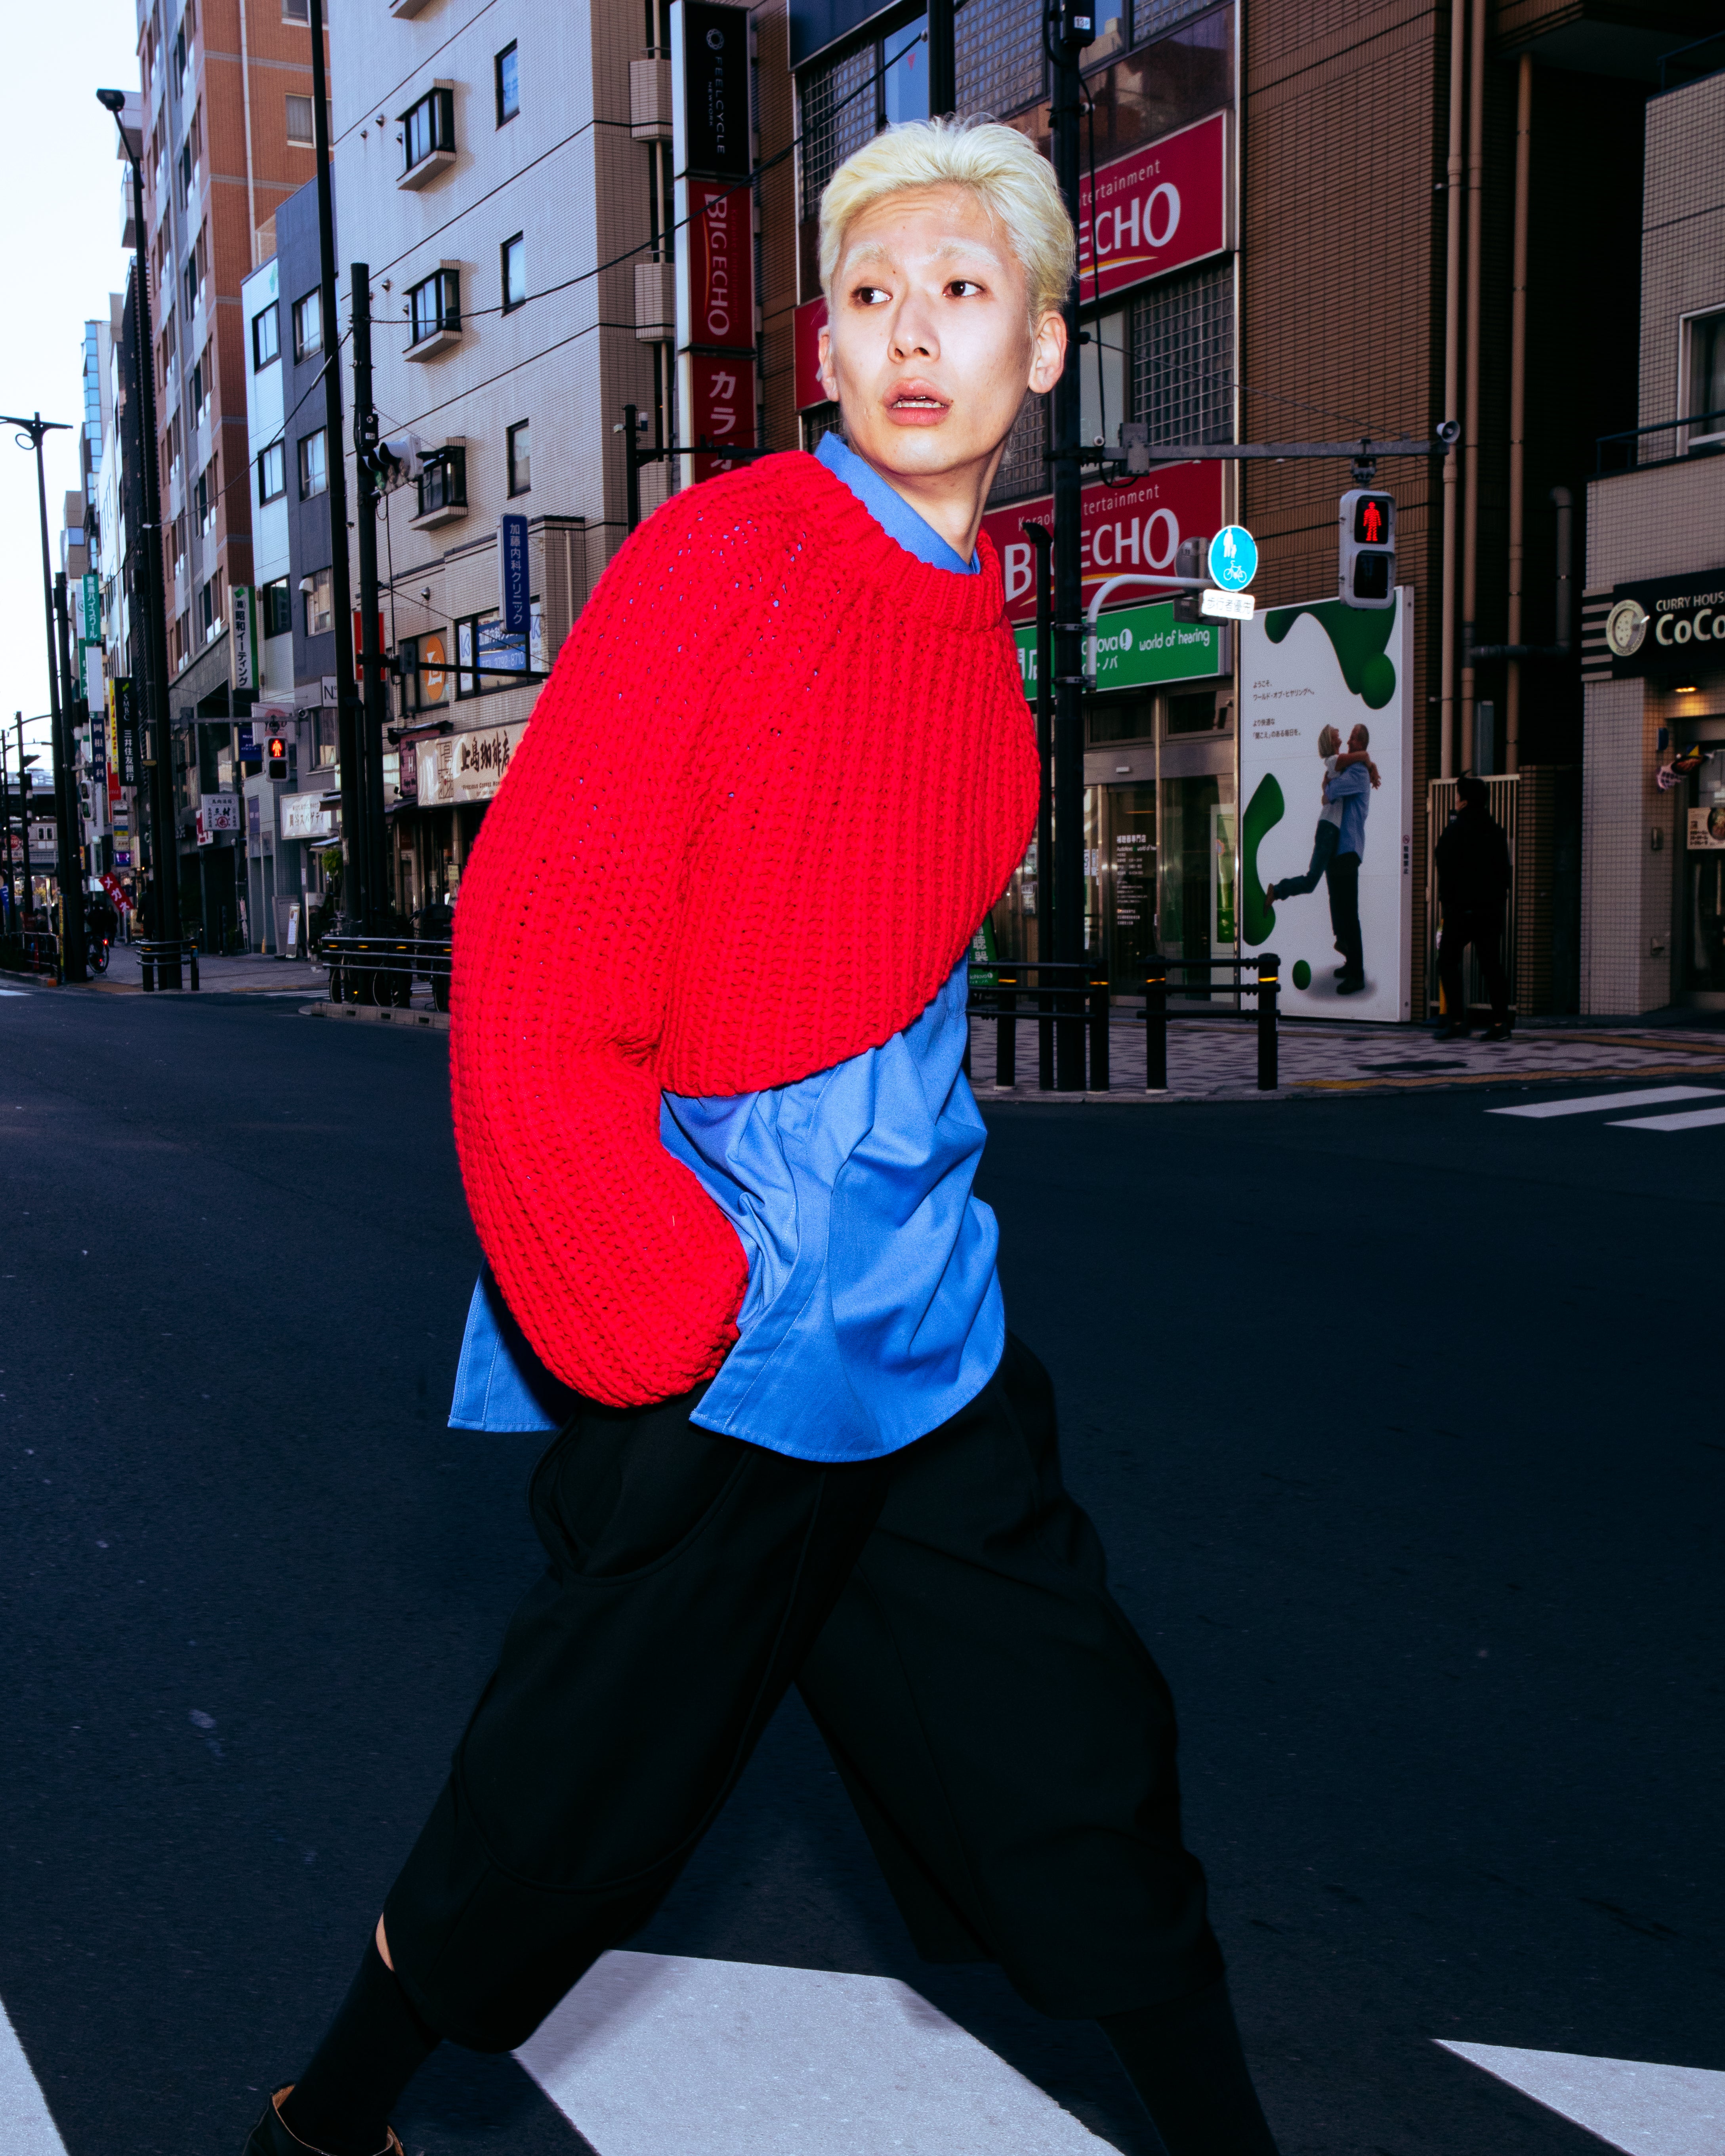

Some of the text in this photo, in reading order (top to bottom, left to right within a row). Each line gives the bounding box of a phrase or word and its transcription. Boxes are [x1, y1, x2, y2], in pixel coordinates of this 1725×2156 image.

[714, 56, 725, 154] FEELCYCLE
[1080, 159, 1160, 206] tertainment
[704, 194, 730, 336] BIG ECHO
[1083, 484, 1159, 516] tertainment
[509, 523, 523, 625] 加藤内科クリニック
[1207, 596, 1251, 614] 歩行者優先
[1656, 591, 1725, 612] CURRY HOUS
[1139, 633, 1163, 651] world
[1165, 629, 1176, 647] of
[1178, 628, 1210, 647] hearing
[1656, 608, 1725, 646] CoCo
[93, 724, 105, 778] 岡根歯科
[124, 730, 134, 782] 三井住友銀行
[460, 730, 511, 777] 上島珈琲店
